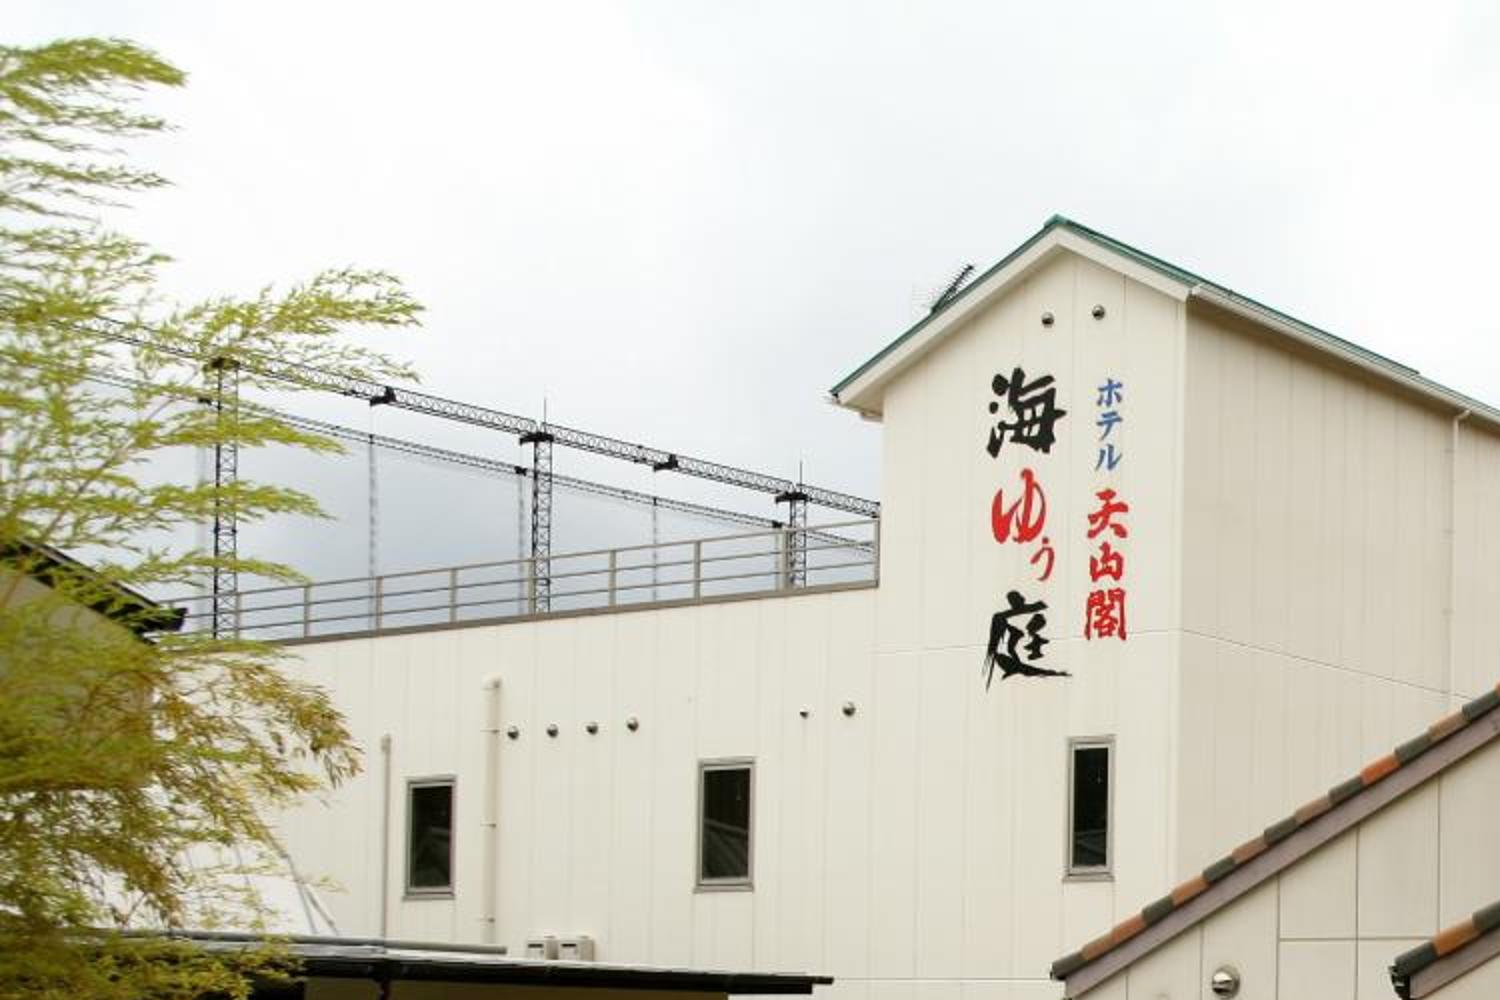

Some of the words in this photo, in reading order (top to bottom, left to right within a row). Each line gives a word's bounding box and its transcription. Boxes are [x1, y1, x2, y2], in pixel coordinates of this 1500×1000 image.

[1095, 378, 1123, 471] ホテル
[1084, 488, 1129, 641] 天山閣
